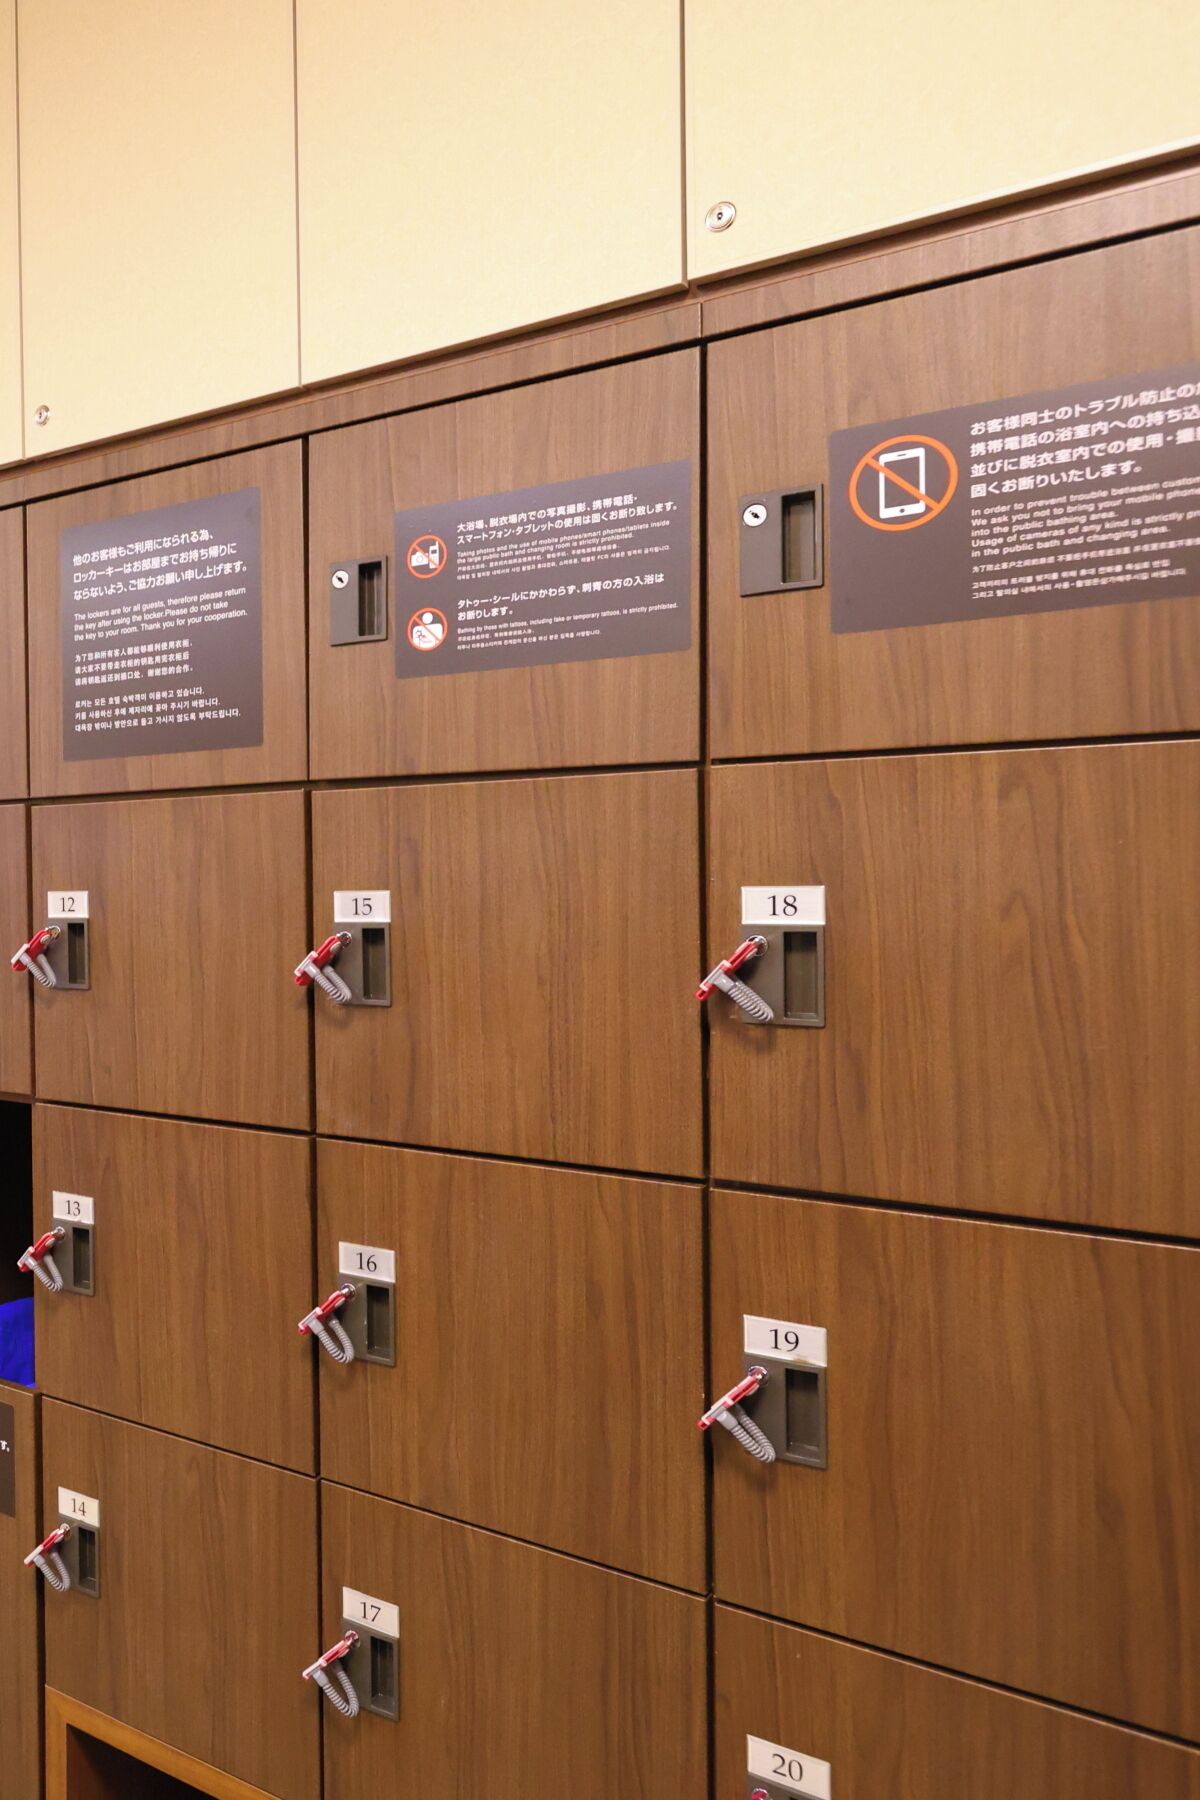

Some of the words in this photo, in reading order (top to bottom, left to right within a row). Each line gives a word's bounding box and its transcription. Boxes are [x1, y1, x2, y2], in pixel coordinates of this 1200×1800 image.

[970, 427, 1200, 478] 並びに脱衣室内での使用・撮
[970, 460, 1142, 498] 固くお断りいたします。
[971, 518, 988, 526] We
[990, 515, 1009, 524] ask
[1012, 513, 1030, 522] you
[1033, 509, 1050, 518] not
[1052, 507, 1064, 515] to
[1066, 503, 1096, 514] bring
[1097, 500, 1123, 510] your
[1125, 492, 1164, 504] mobile
[984, 505, 1011, 514] order
[1027, 496, 1067, 510] prevent
[1069, 490, 1109, 502] trouble
[1111, 483, 1160, 496] between
[458, 548, 476, 558] Taking
[476, 546, 496, 556] photos
[497, 544, 508, 552] and
[539, 537, 558, 545] mobile
[650, 520, 670, 528] inside
[971, 528, 990, 537] into
[992, 526, 1010, 534] the
[1012, 521, 1044, 532] public
[1046, 515, 1088, 526] bathing
[972, 538, 1004, 548] Usage
[1006, 534, 1018, 543] of
[1020, 529, 1066, 540] cameras
[1068, 526, 1080, 534] of
[1081, 524, 1102, 533] any
[1104, 518, 1130, 528] kind
[1131, 517, 1142, 526] is
[1144, 512, 1185, 524] strictly
[73, 529, 213, 566] 他のお客様もご利用になられる為、
[467, 556, 482, 564] large
[482, 554, 500, 562] public
[515, 548, 526, 556] and
[527, 544, 554, 554] changing
[556, 542, 570, 550] room
[579, 536, 600, 546] strictly
[601, 532, 634, 543] prohibited.
[972, 550, 981, 558] in
[984, 547, 1000, 556] the
[1002, 542, 1034, 554] public
[1036, 540, 1061, 549] bath
[1063, 536, 1084, 546] and
[1086, 530, 1138, 542] changing
[73, 543, 237, 583] ロッカーキーはお部屋までお持ち帰りに
[74, 560, 247, 600] ならないよう、ご協力お願い申し上げます。
[74, 624, 84, 632] the
[86, 622, 96, 631] key
[98, 619, 112, 628] after
[114, 616, 130, 626] using
[132, 614, 142, 622] the
[190, 605, 198, 613] do
[200, 603, 212, 612] not
[213, 601, 228, 610] take
[88, 610, 110, 619] lockers
[142, 600, 166, 612] guests,
[168, 595, 198, 606] therefore
[200, 591, 222, 602] please
[225, 587, 246, 597] return
[458, 606, 513, 621] お断りします。
[74, 634, 84, 642] the
[86, 632, 96, 640] key
[98, 630, 104, 638] to
[106, 628, 120, 638] your
[120, 626, 139, 634] room.
[140, 622, 161, 632] Thank
[162, 620, 174, 630] you
[176, 618, 186, 626] for
[188, 616, 202, 626] your
[204, 608, 248, 622] cooperation.
[60, 897, 76, 912] 12
[352, 897, 373, 916] 15
[768, 894, 798, 917] 18
[65, 1199, 81, 1216] 13
[356, 1252, 378, 1274] 16
[769, 1328, 800, 1352] 19
[71, 1498, 87, 1518] 14
[359, 1601, 382, 1622] 17
[771, 1753, 804, 1783] 20
